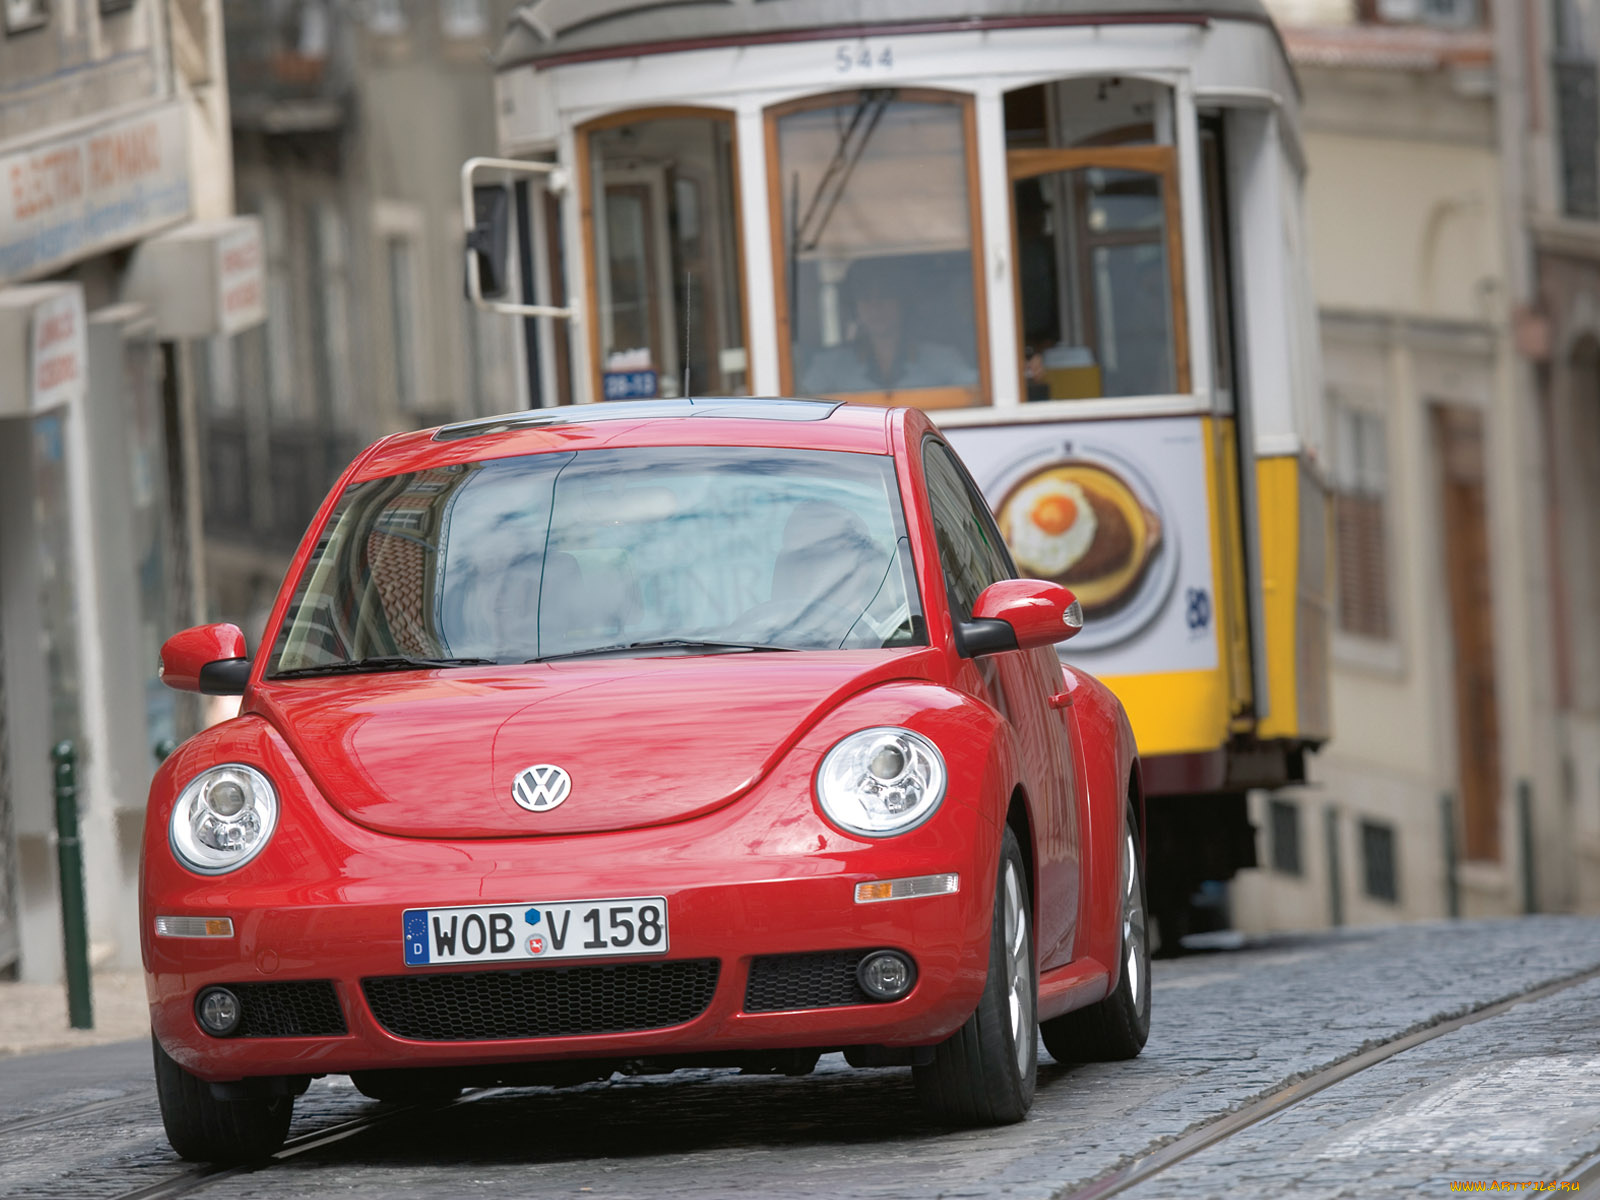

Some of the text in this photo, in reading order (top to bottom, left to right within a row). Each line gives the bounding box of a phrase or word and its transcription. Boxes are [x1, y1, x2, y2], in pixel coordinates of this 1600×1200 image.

[836, 45, 894, 73] 544
[413, 905, 661, 956] D WOB V 158
